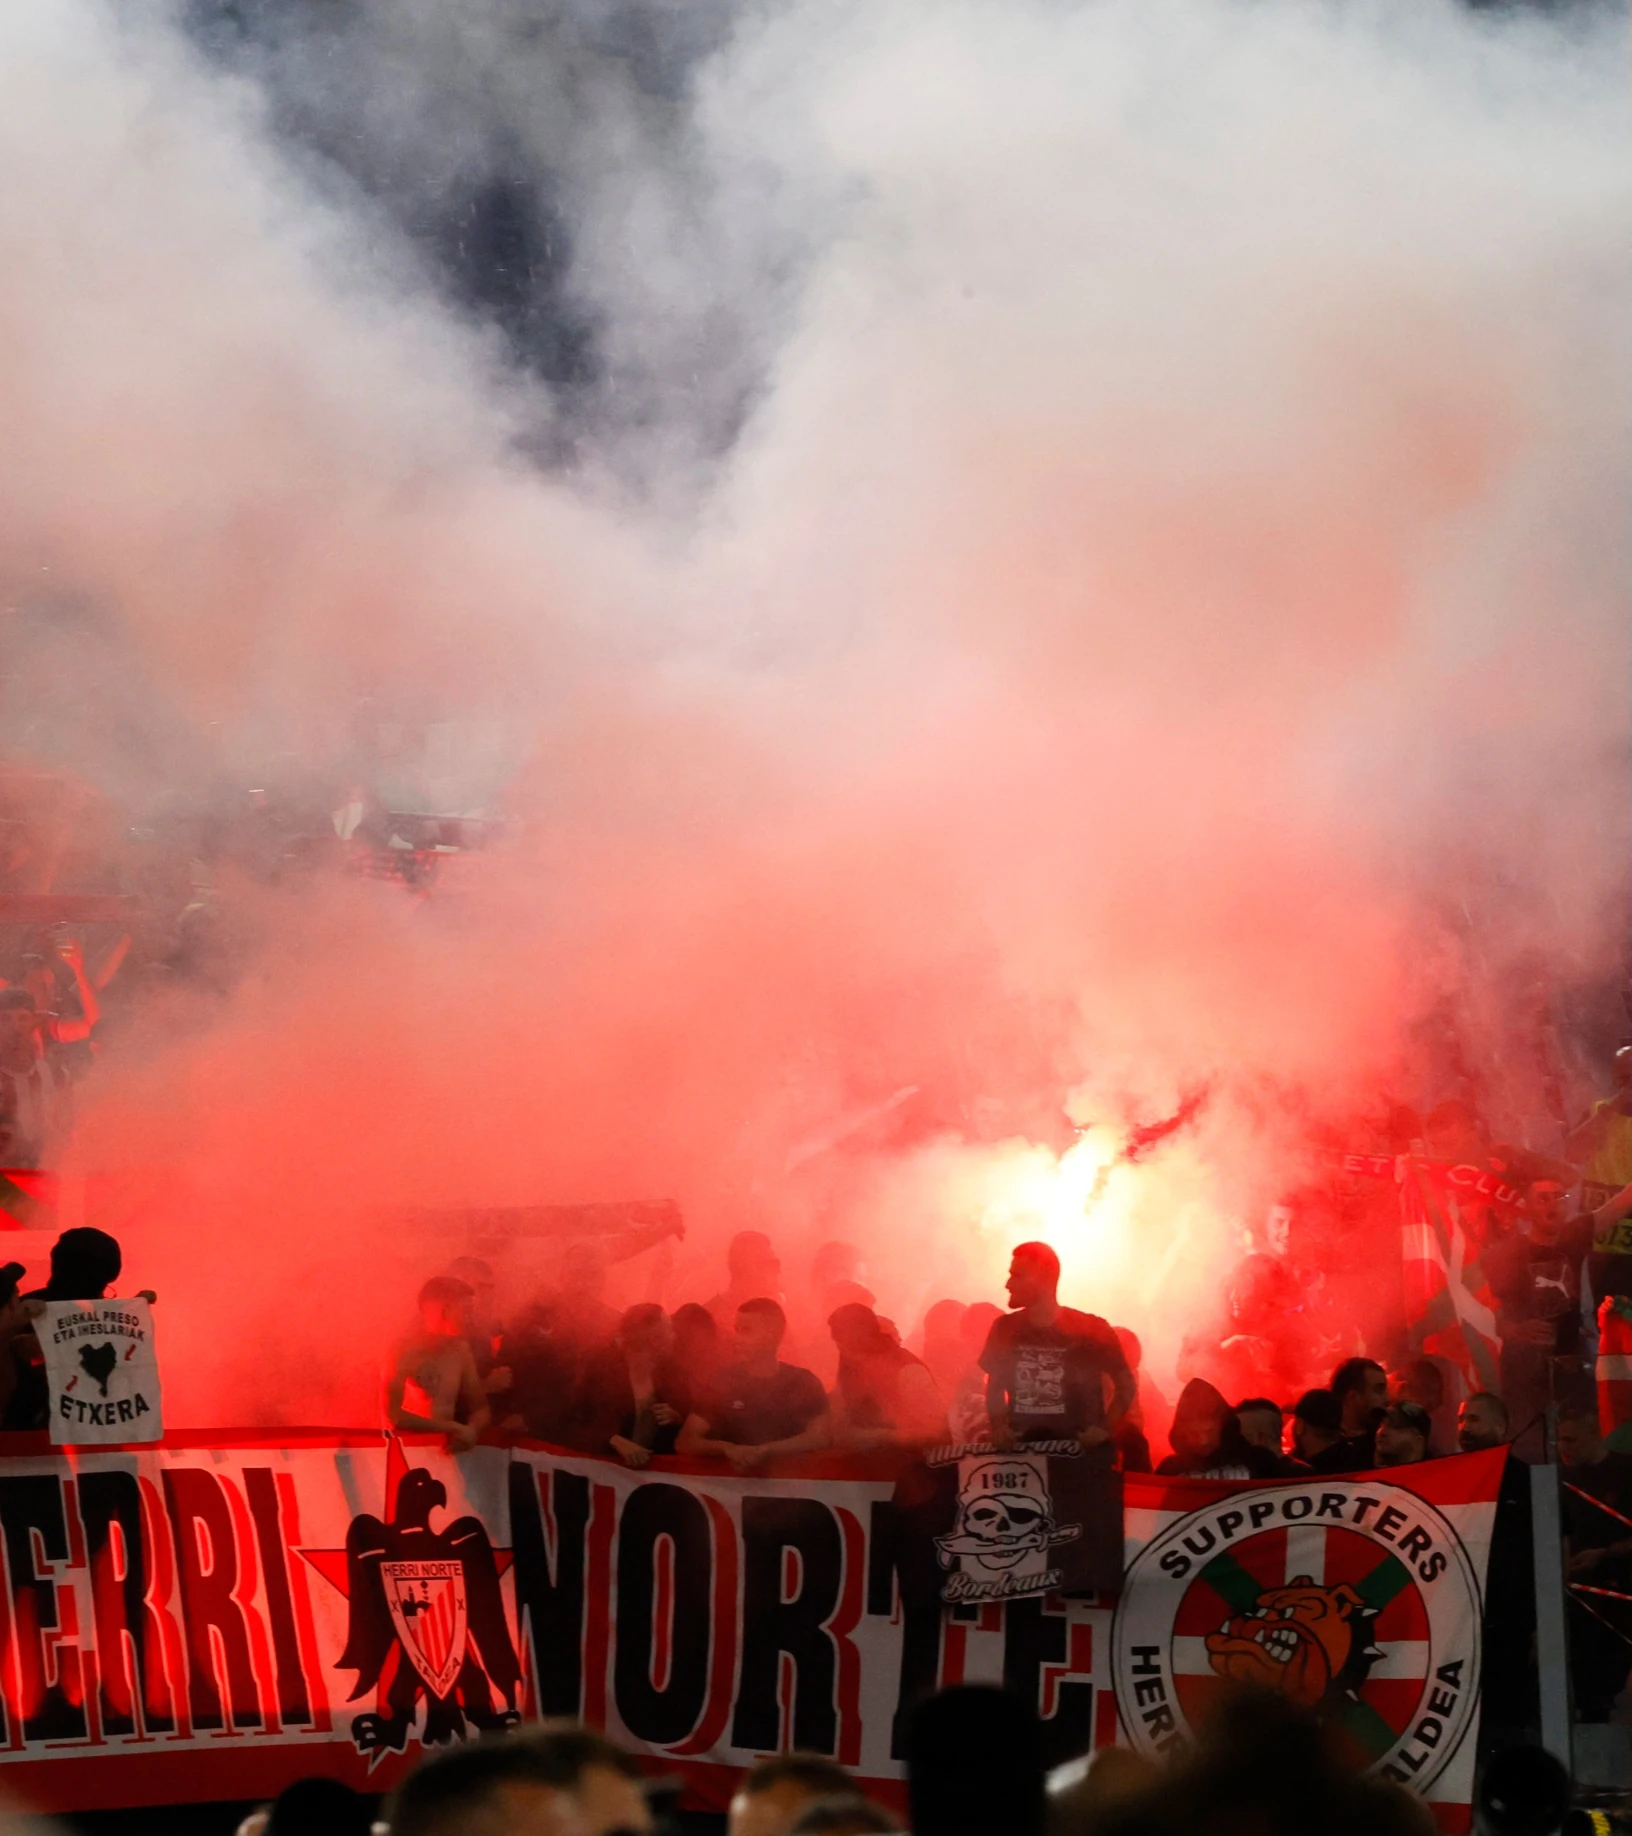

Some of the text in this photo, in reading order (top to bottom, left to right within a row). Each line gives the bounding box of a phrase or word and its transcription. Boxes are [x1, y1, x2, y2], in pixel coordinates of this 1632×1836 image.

[53, 1323, 146, 1344] ETA IHESLARIAK
[57, 1311, 139, 1329] EUSKAL PRESO
[60, 1392, 150, 1426] ETXERA
[981, 1472, 1031, 1490] 1987
[1160, 1492, 1448, 1583] SUPPORTERS
[383, 1562, 462, 1577] HERRI NORTE
[944, 1568, 1063, 1601] Bordeaux
[0, 1467, 328, 1742] ERRI
